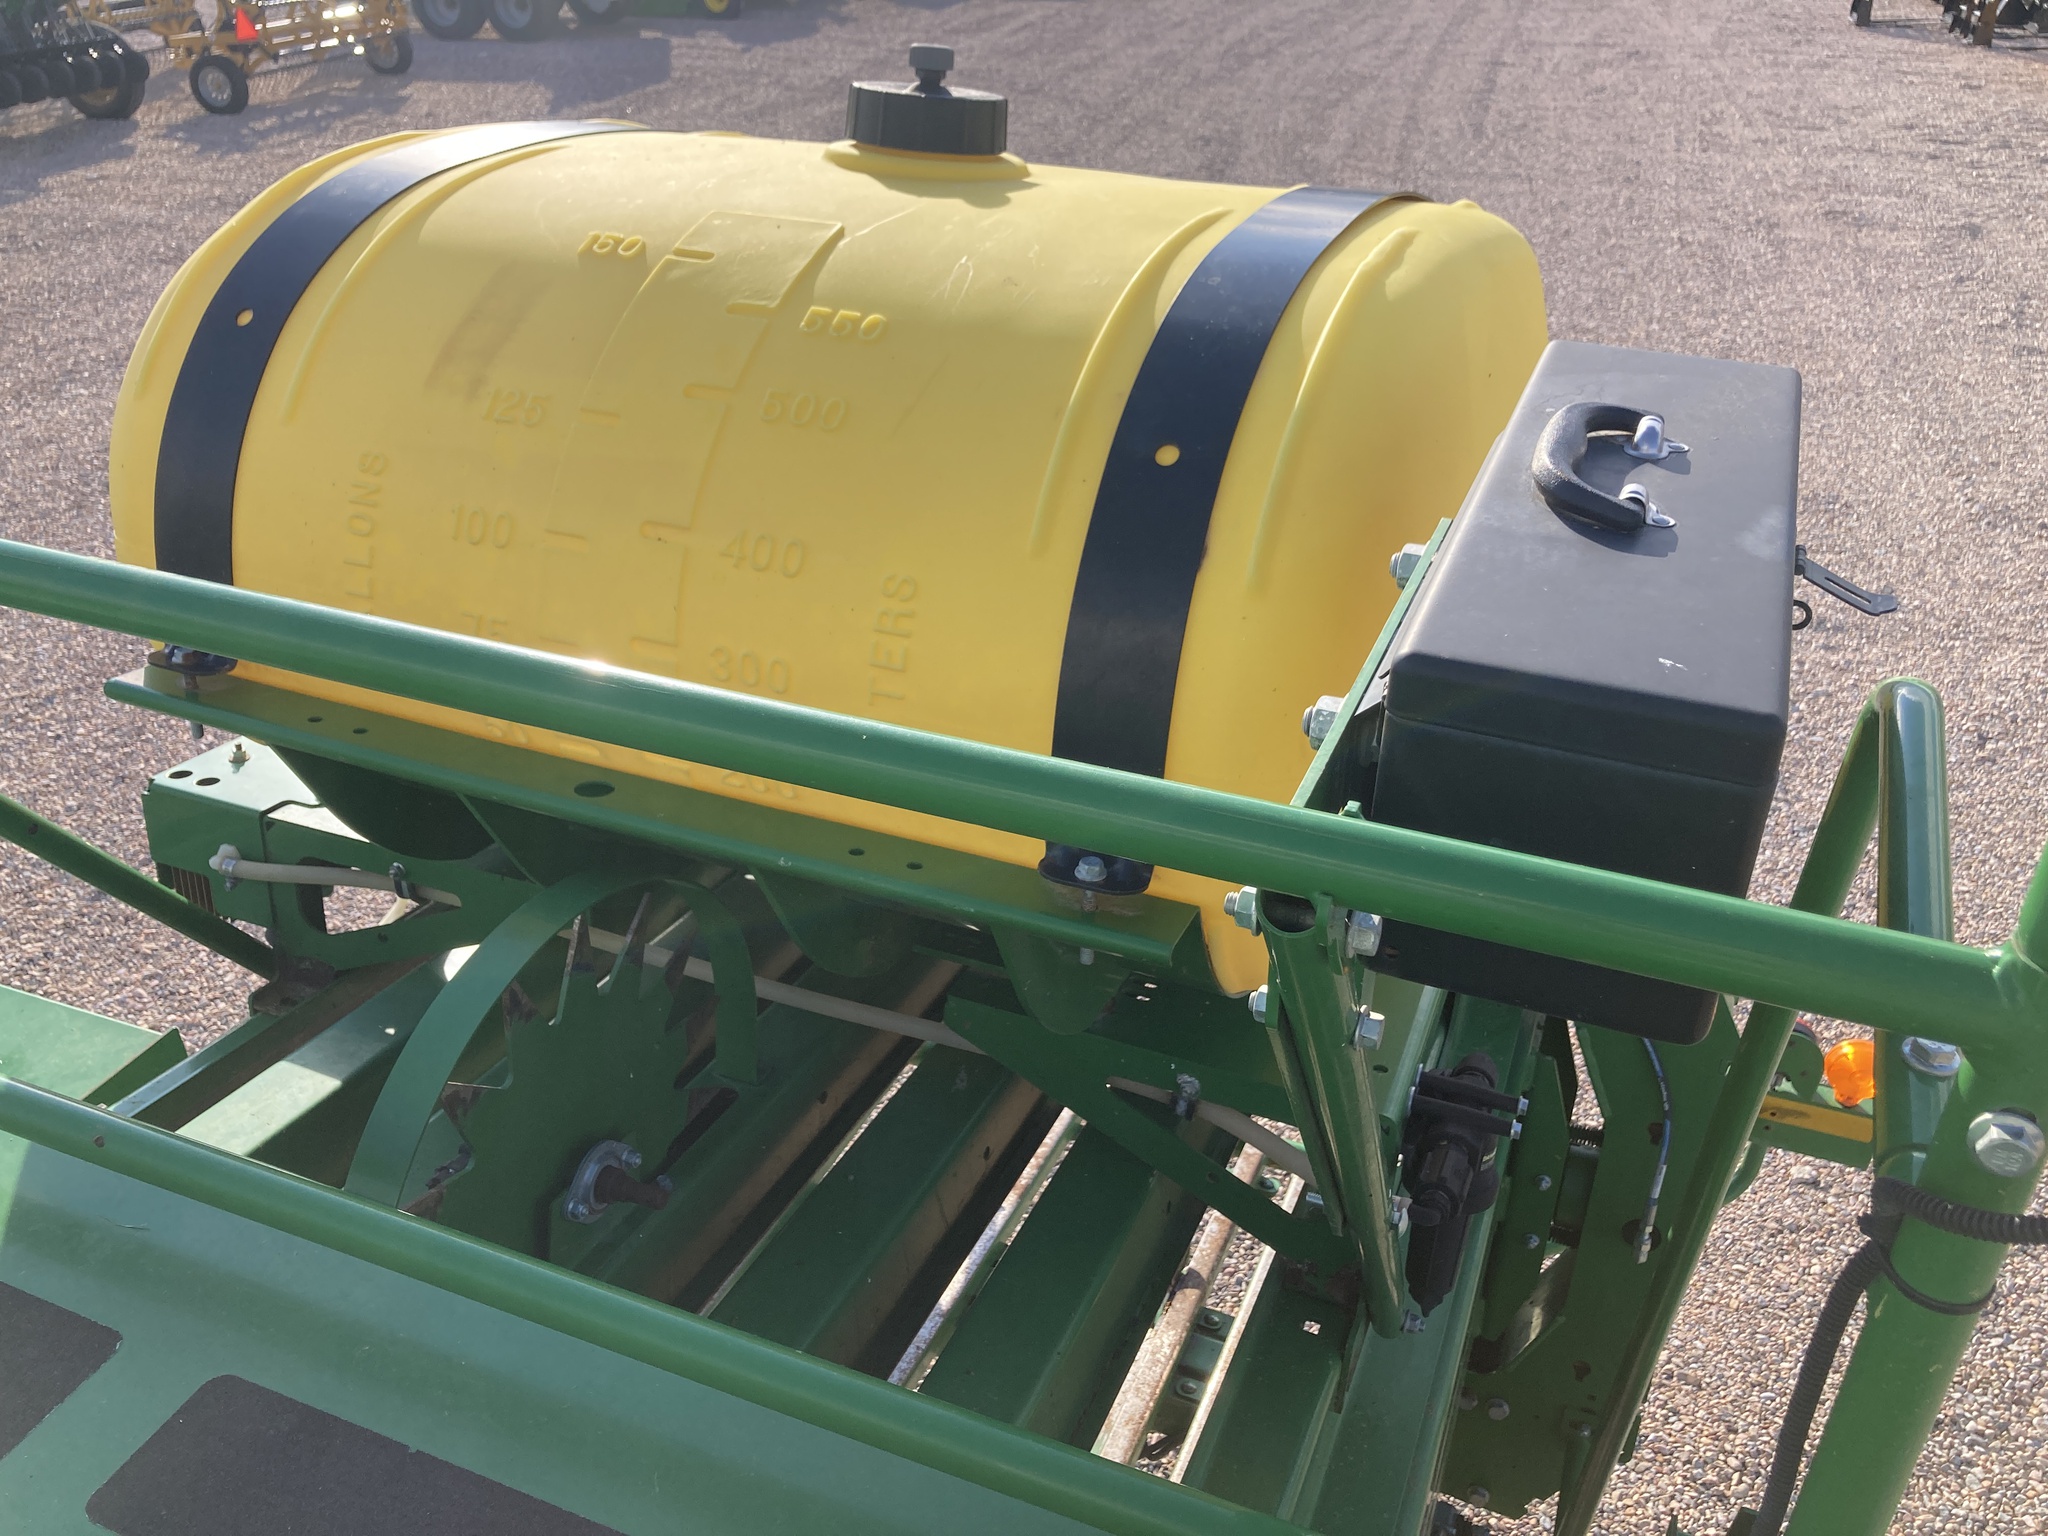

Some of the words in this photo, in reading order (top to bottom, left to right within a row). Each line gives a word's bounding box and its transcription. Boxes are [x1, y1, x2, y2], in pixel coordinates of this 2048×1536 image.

[577, 231, 646, 257] 150
[800, 304, 888, 341] 550
[481, 387, 550, 428] 125
[759, 388, 849, 432] 500
[343, 452, 389, 612] LLONS
[451, 504, 514, 549] 100
[719, 530, 806, 579] 400
[868, 573, 918, 706] TERS
[709, 645, 791, 695] 300
